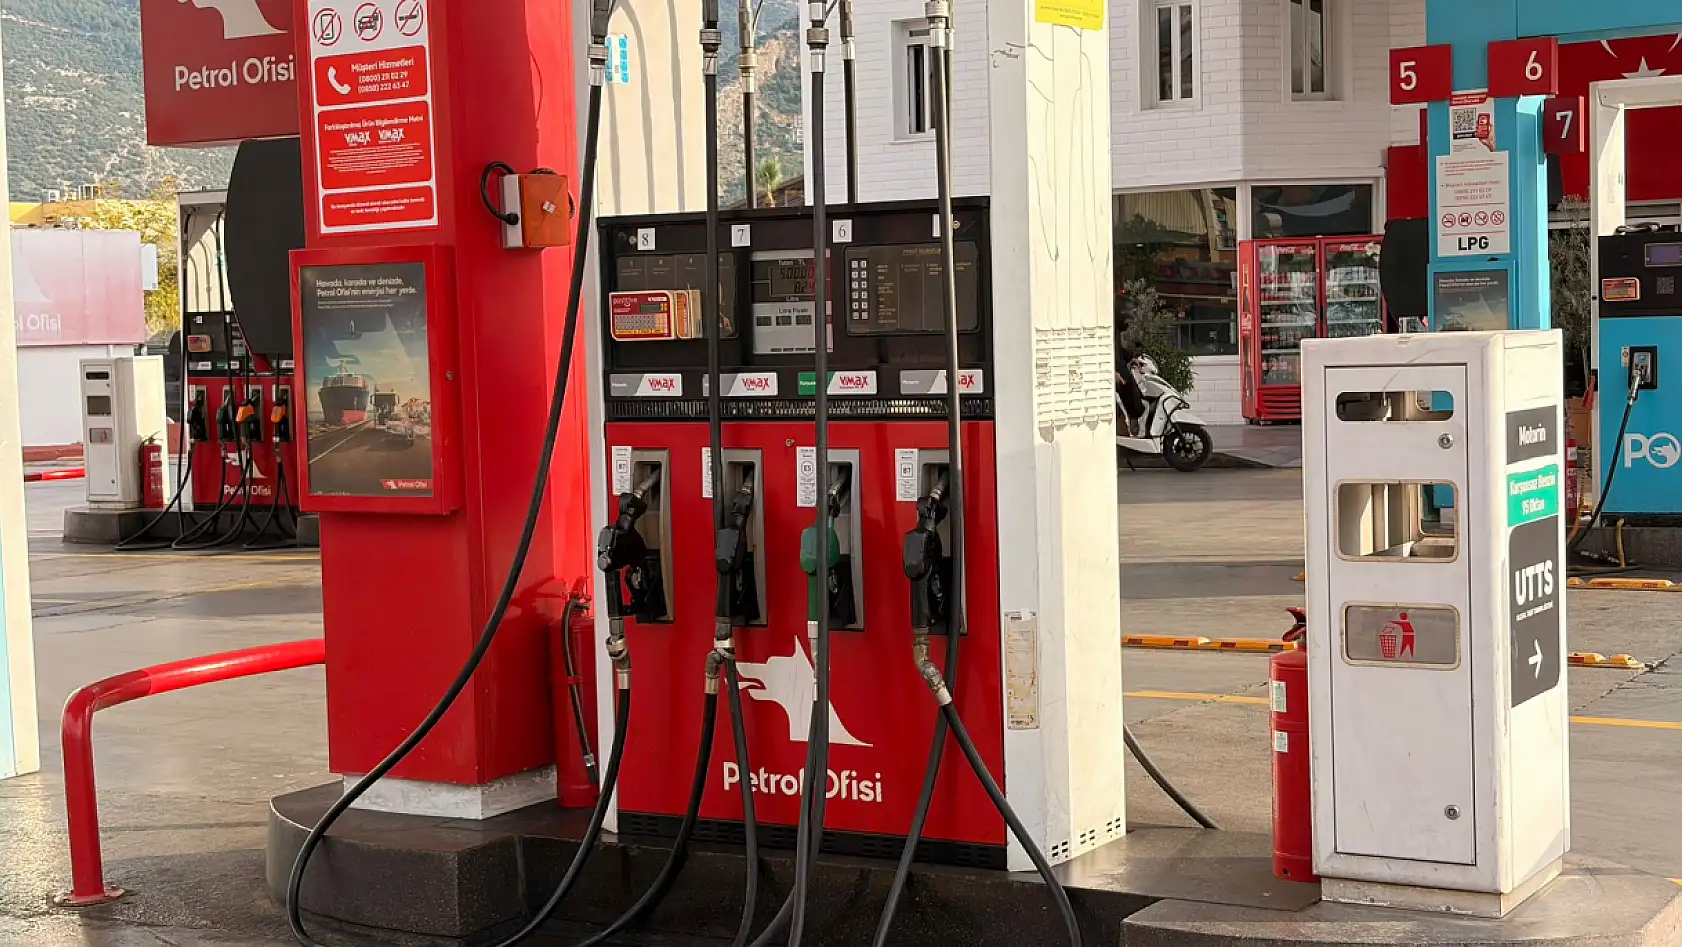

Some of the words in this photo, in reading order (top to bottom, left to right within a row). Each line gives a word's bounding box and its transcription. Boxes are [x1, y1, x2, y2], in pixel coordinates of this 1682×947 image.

[174, 60, 238, 92] Petrol
[242, 54, 294, 84] Ofisi
[378, 57, 414, 69] Hizmetleri
[1525, 50, 1543, 81] 6
[1399, 60, 1417, 91] 5
[1555, 110, 1573, 139] 7
[641, 232, 649, 247] 8
[737, 228, 745, 243] 7
[838, 224, 846, 238] 6
[1458, 236, 1489, 251] LPG
[1519, 423, 1546, 446] Motorin
[1515, 559, 1553, 606] UTTS
